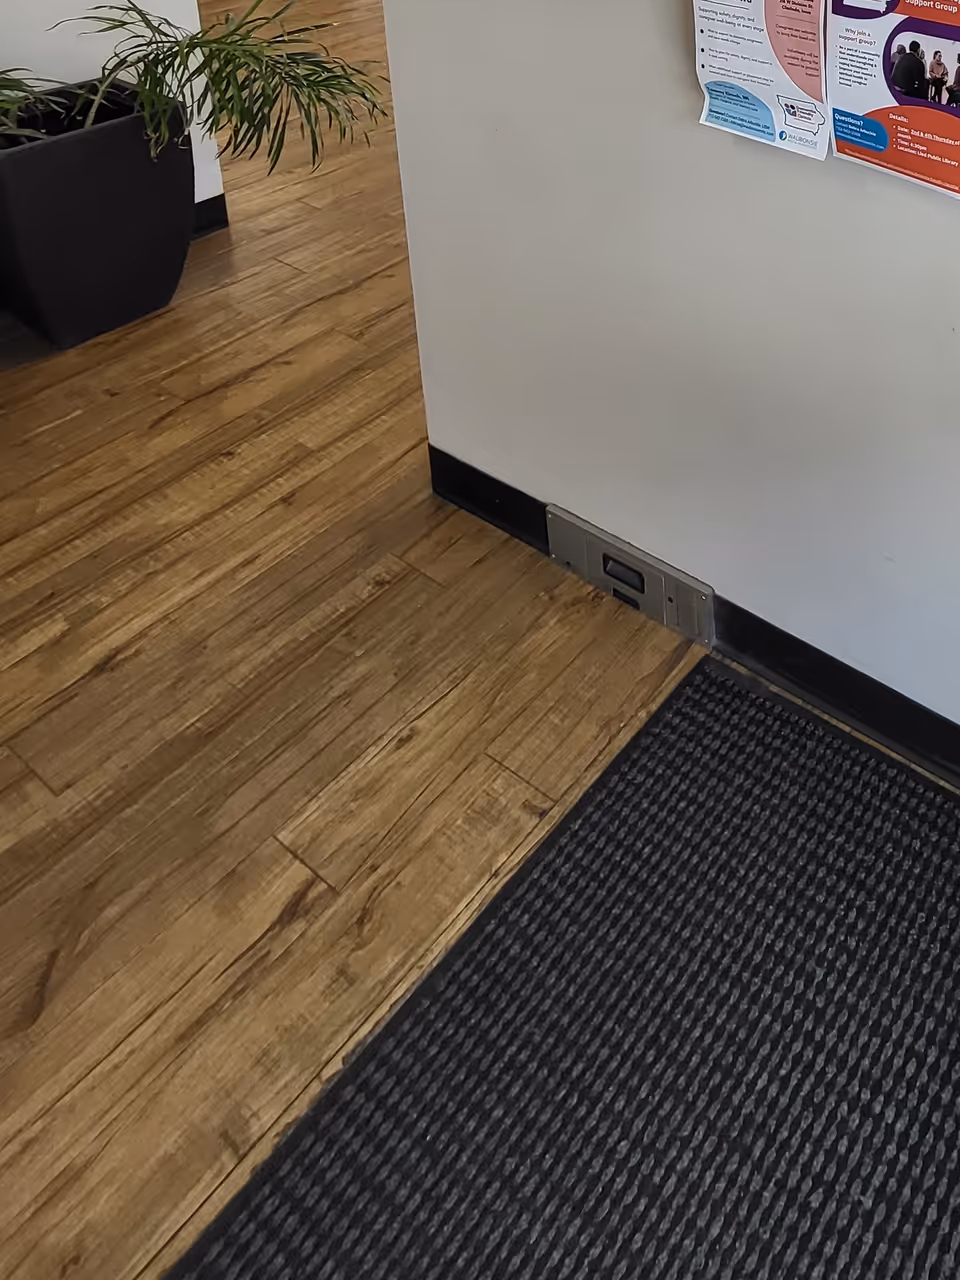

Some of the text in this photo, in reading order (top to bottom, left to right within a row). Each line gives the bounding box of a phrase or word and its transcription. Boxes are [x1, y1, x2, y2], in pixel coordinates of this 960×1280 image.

[935, 2, 958, 13] Group
[834, 113, 864, 126] Questions?
[889, 113, 909, 123] Details:
[933, 133, 955, 145] Thursday
[928, 151, 941, 162] Public
[942, 156, 959, 167] Library
